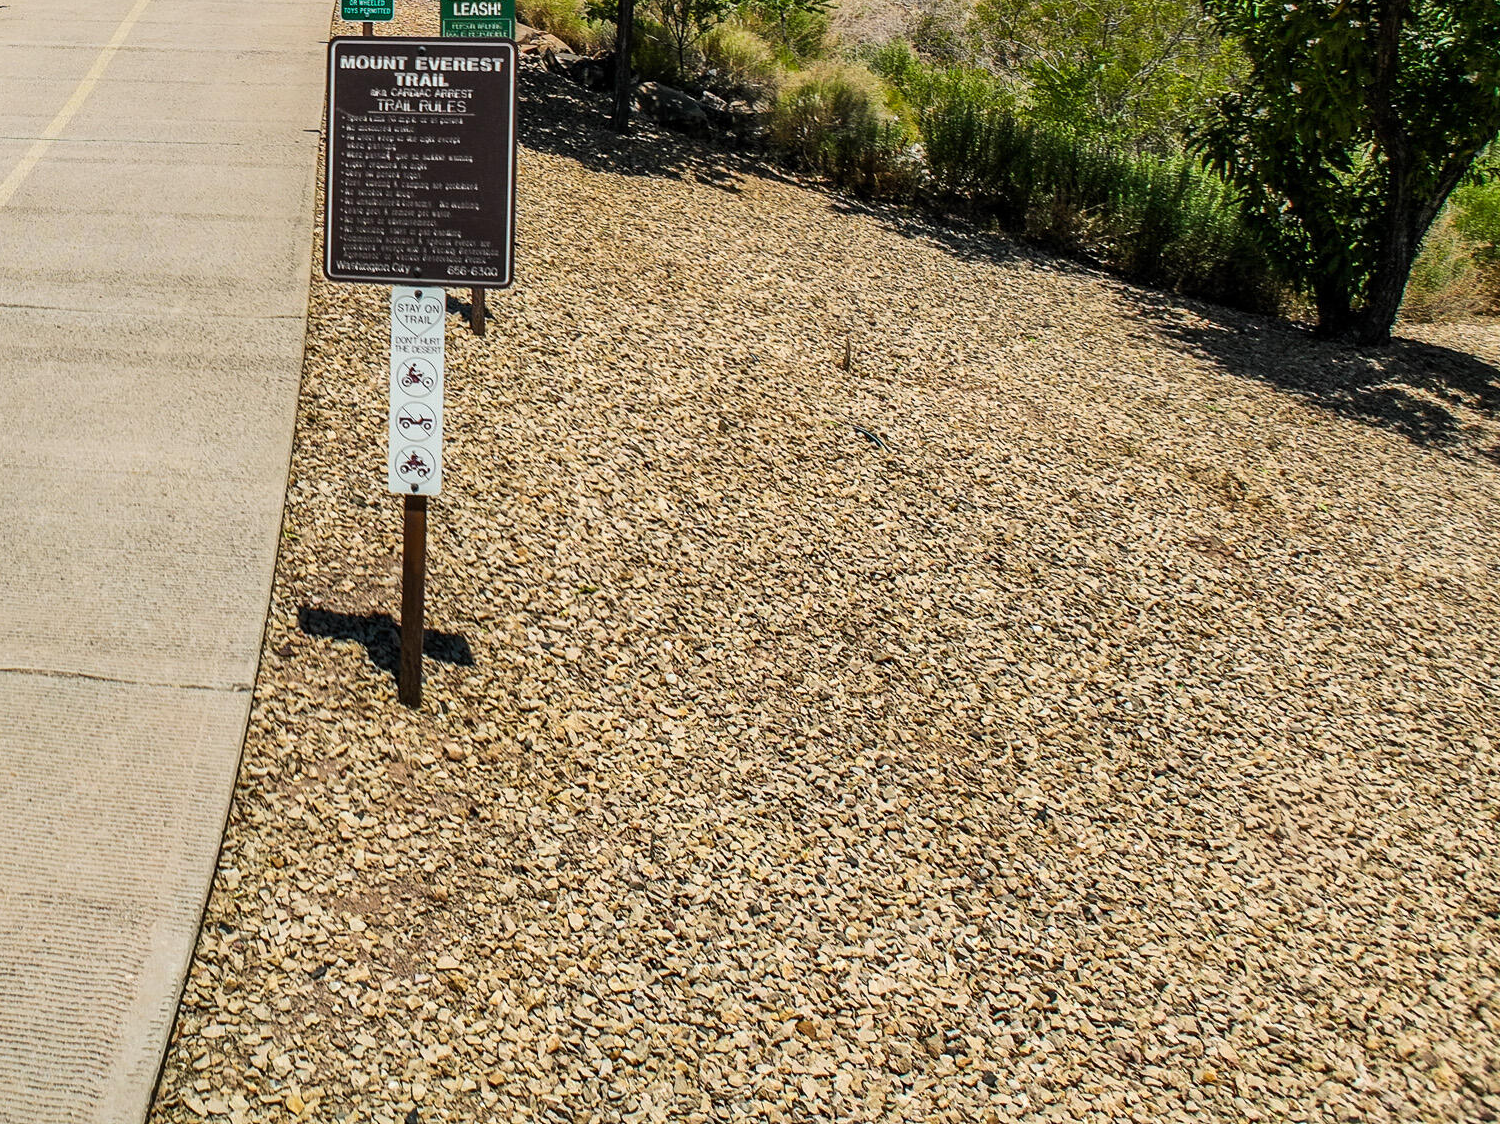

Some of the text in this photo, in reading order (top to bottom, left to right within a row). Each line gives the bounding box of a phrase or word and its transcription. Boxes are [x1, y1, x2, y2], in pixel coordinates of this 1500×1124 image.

[453, 2, 502, 16] LEASH!
[340, 55, 504, 72] MOUNT EVEREST
[394, 72, 450, 87] TRAIL
[370, 88, 474, 99] aka CARDIAC ARREST
[376, 98, 468, 113] TRAIL RULES
[335, 260, 411, 274] Washington City
[398, 304, 440, 314] STAY ON
[404, 315, 432, 324] TRAIL
[420, 338, 440, 346] HURT
[395, 345, 442, 354] THE DESERT
